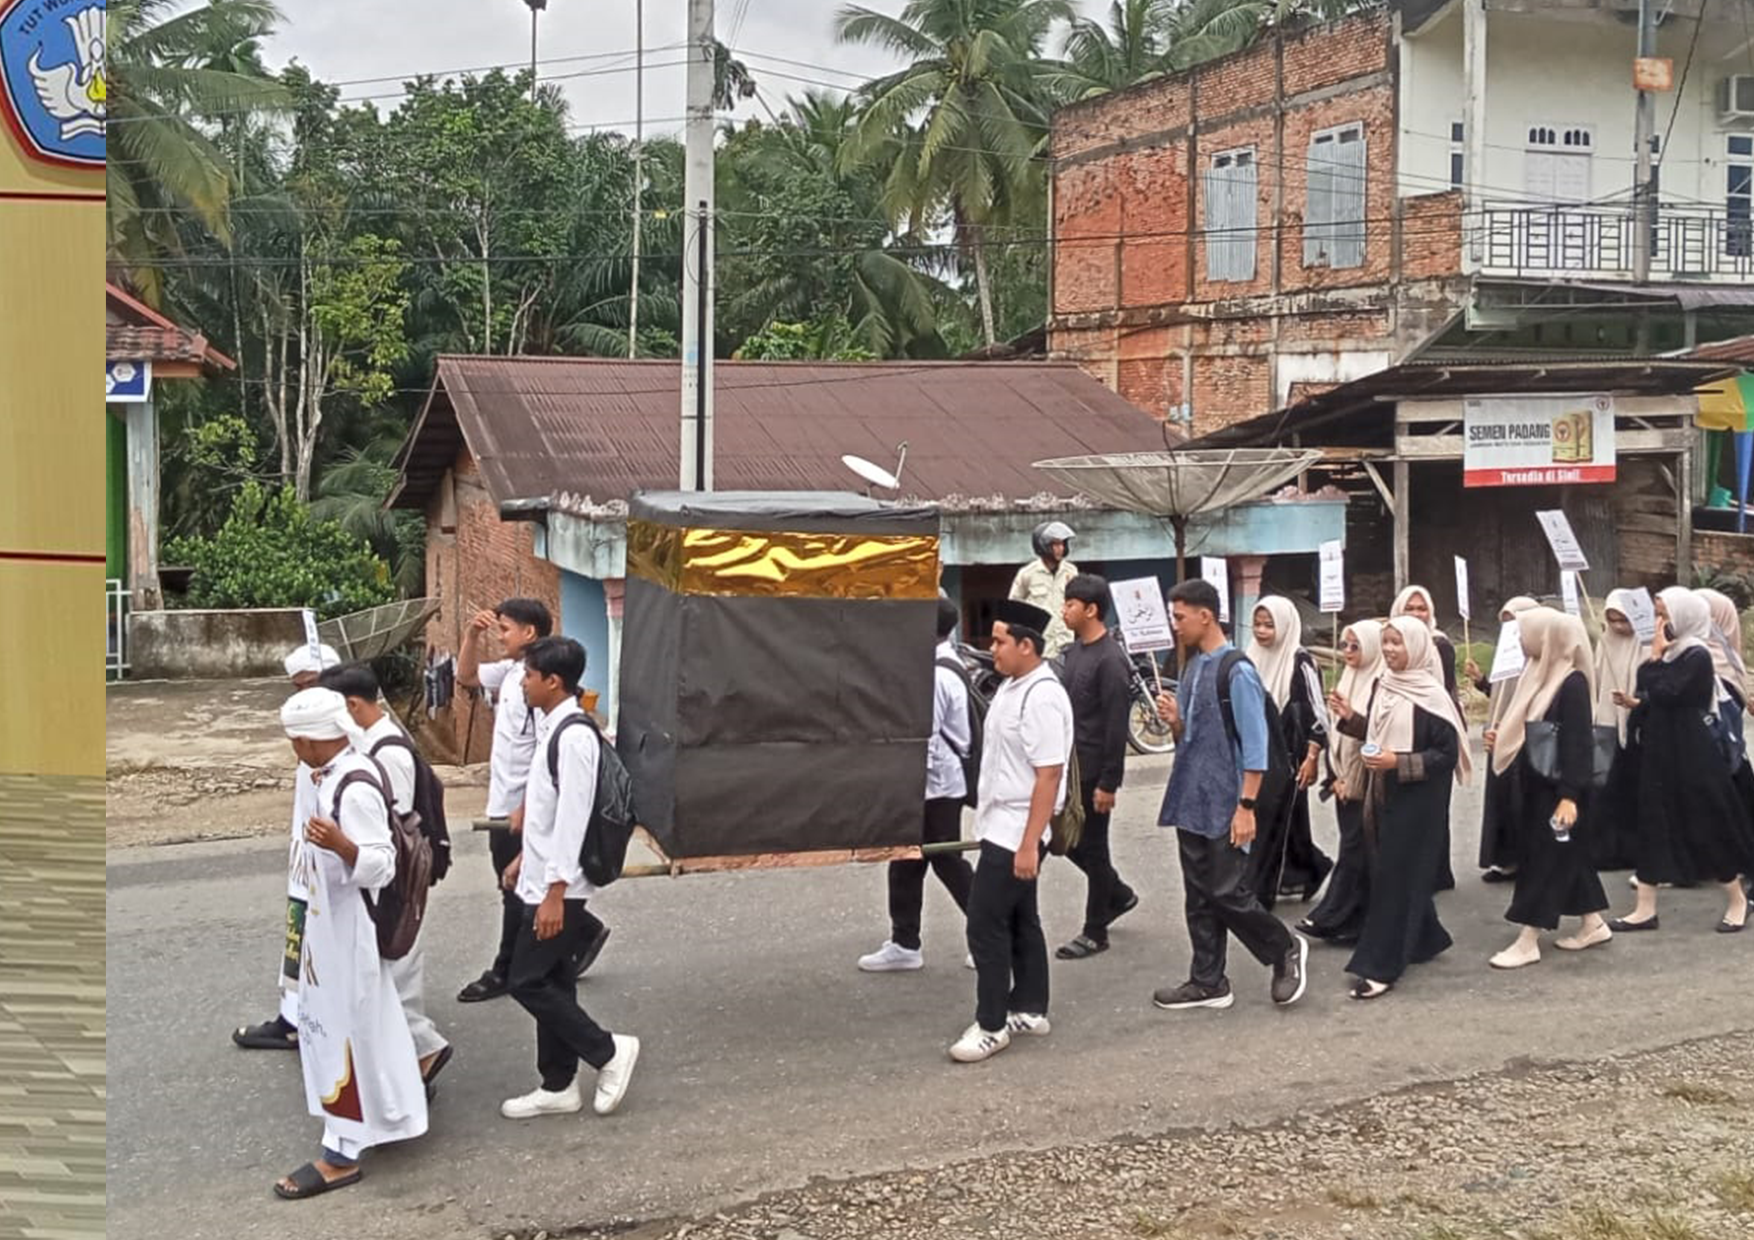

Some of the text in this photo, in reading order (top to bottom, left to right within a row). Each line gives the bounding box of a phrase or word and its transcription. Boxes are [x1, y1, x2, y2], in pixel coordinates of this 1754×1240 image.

[19, 7, 43, 35] TUT
[1469, 422, 1551, 441] SEMEN PADANG
